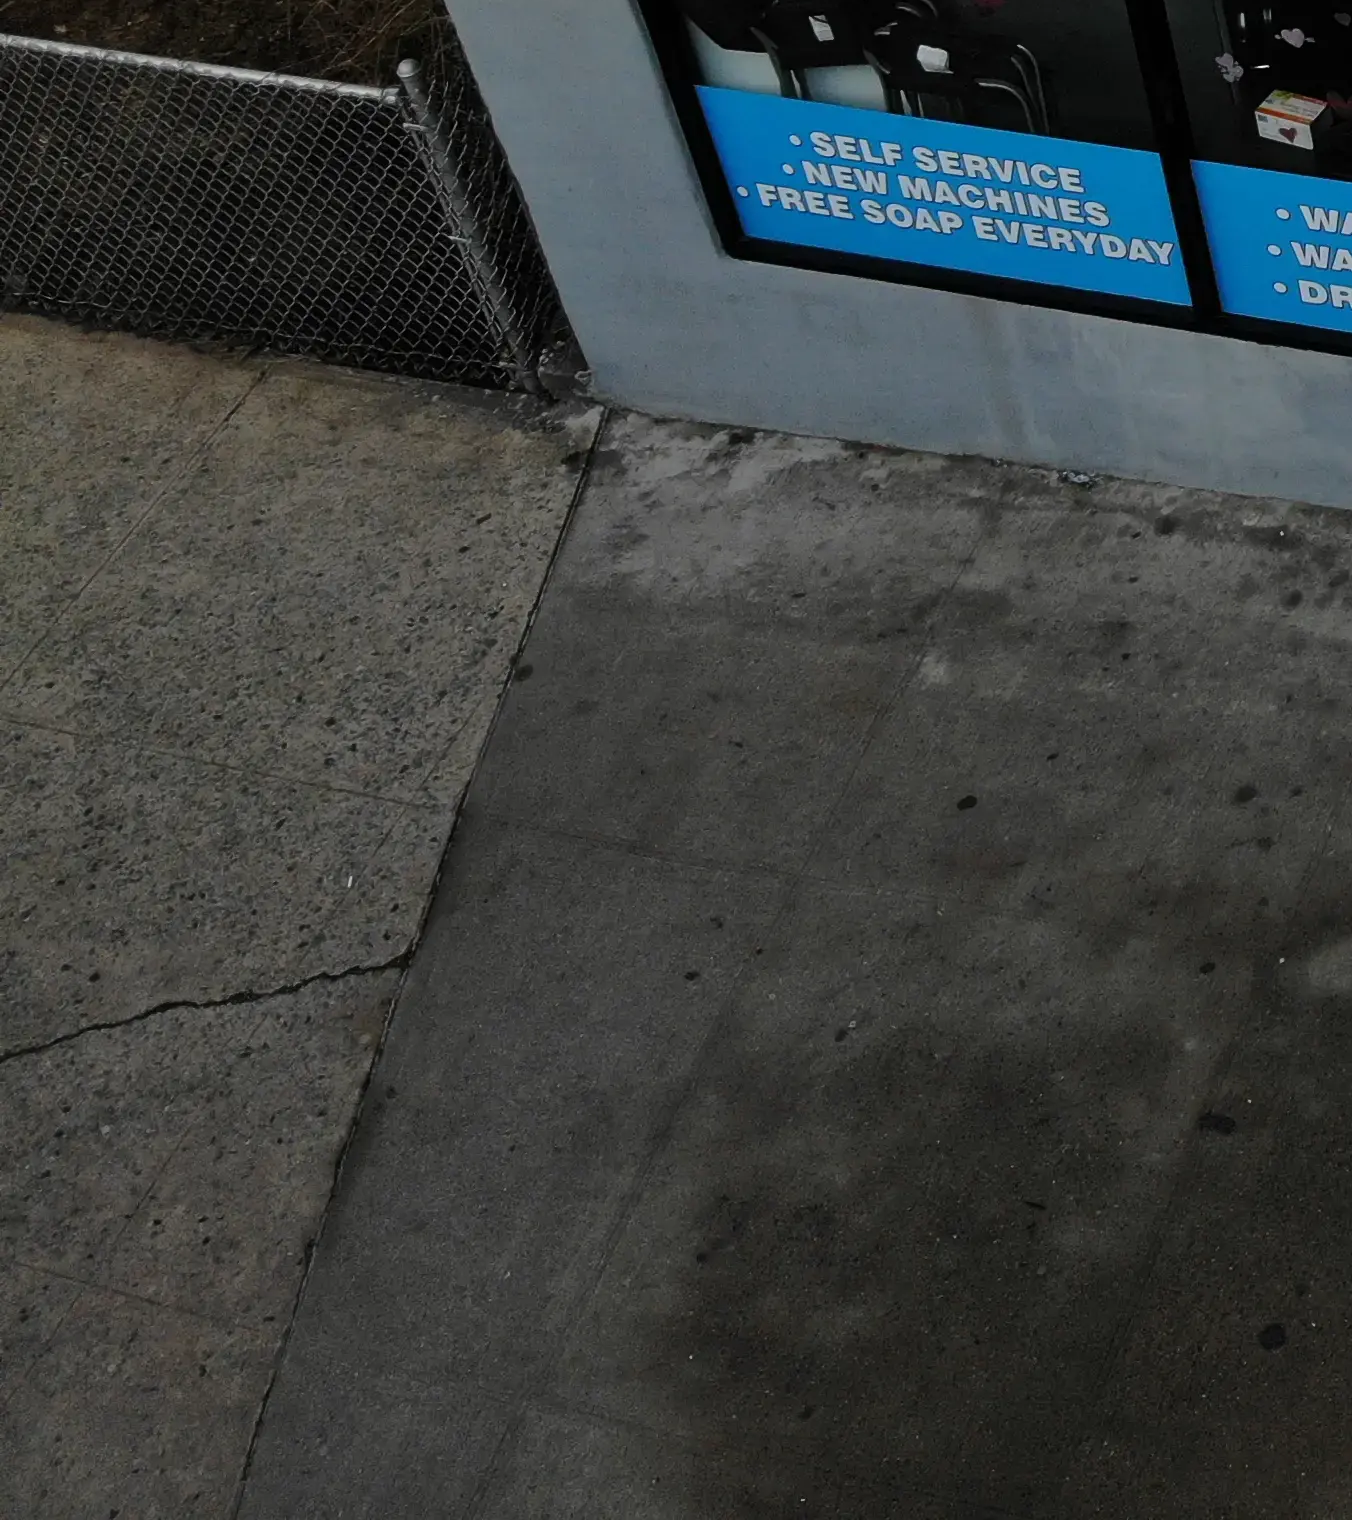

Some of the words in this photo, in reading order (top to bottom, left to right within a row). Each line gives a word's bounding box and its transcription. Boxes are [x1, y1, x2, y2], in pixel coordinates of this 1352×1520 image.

[802, 160, 888, 195] NEW
[898, 175, 1110, 228] MACHINES
[809, 131, 903, 167] SELF
[912, 146, 1085, 193] SERVICE
[756, 182, 854, 220] FREE
[863, 199, 963, 236] SOAP
[971, 216, 1174, 266] EVERYDAY
